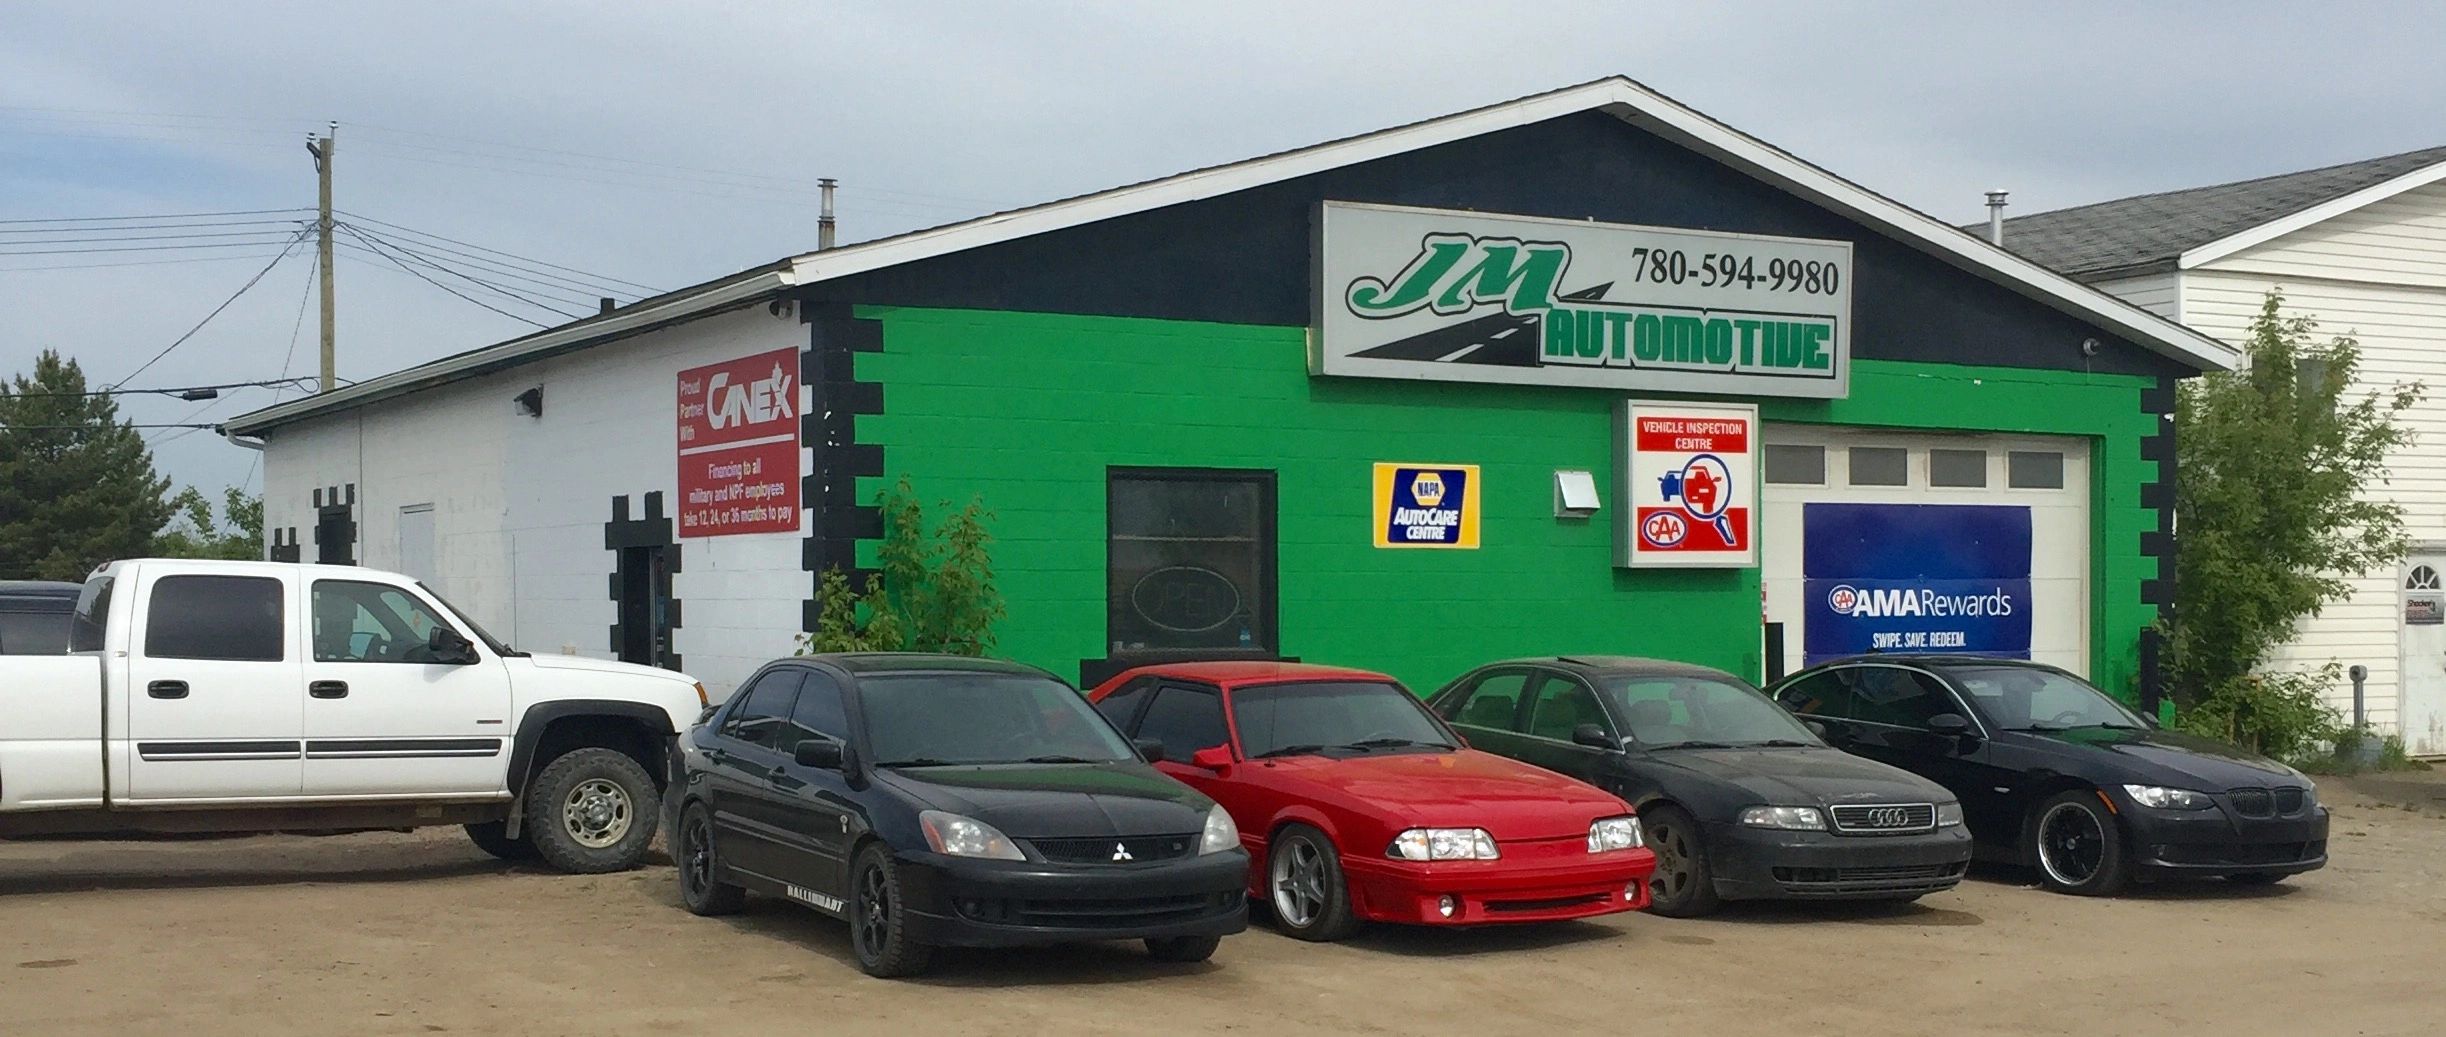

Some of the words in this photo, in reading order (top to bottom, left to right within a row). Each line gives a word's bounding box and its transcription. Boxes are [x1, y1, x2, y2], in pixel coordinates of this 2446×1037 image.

[1351, 242, 1565, 312] JM
[1631, 247, 1840, 296] 780-594-9980
[1544, 308, 1832, 370] AUTOMOTIVE
[680, 378, 701, 397] Proud
[707, 360, 793, 430] CANEX
[680, 402, 705, 419] Partner
[1643, 421, 1684, 434] VEHICLE
[1686, 423, 1742, 435] INSPECTION
[1675, 438, 1713, 450] CENTRE
[708, 461, 743, 480] Financing
[743, 460, 752, 476] to
[752, 457, 762, 475] all
[689, 487, 713, 506] military
[714, 484, 728, 502] and
[729, 482, 744, 500] NPF
[744, 481, 785, 501] employees
[1417, 482, 1440, 497] NAPA
[721, 511, 730, 524] or
[740, 505, 767, 522] months
[768, 504, 777, 520] to
[777, 506, 793, 523] pay
[1405, 525, 1446, 540] CENTRE
[1648, 515, 1681, 541] CAA
[1922, 587, 2012, 617] Rewards
[1872, 632, 1903, 649] SWIPE.
[1903, 632, 1928, 648] SAVE.
[1929, 631, 1967, 647] REDEEM.
